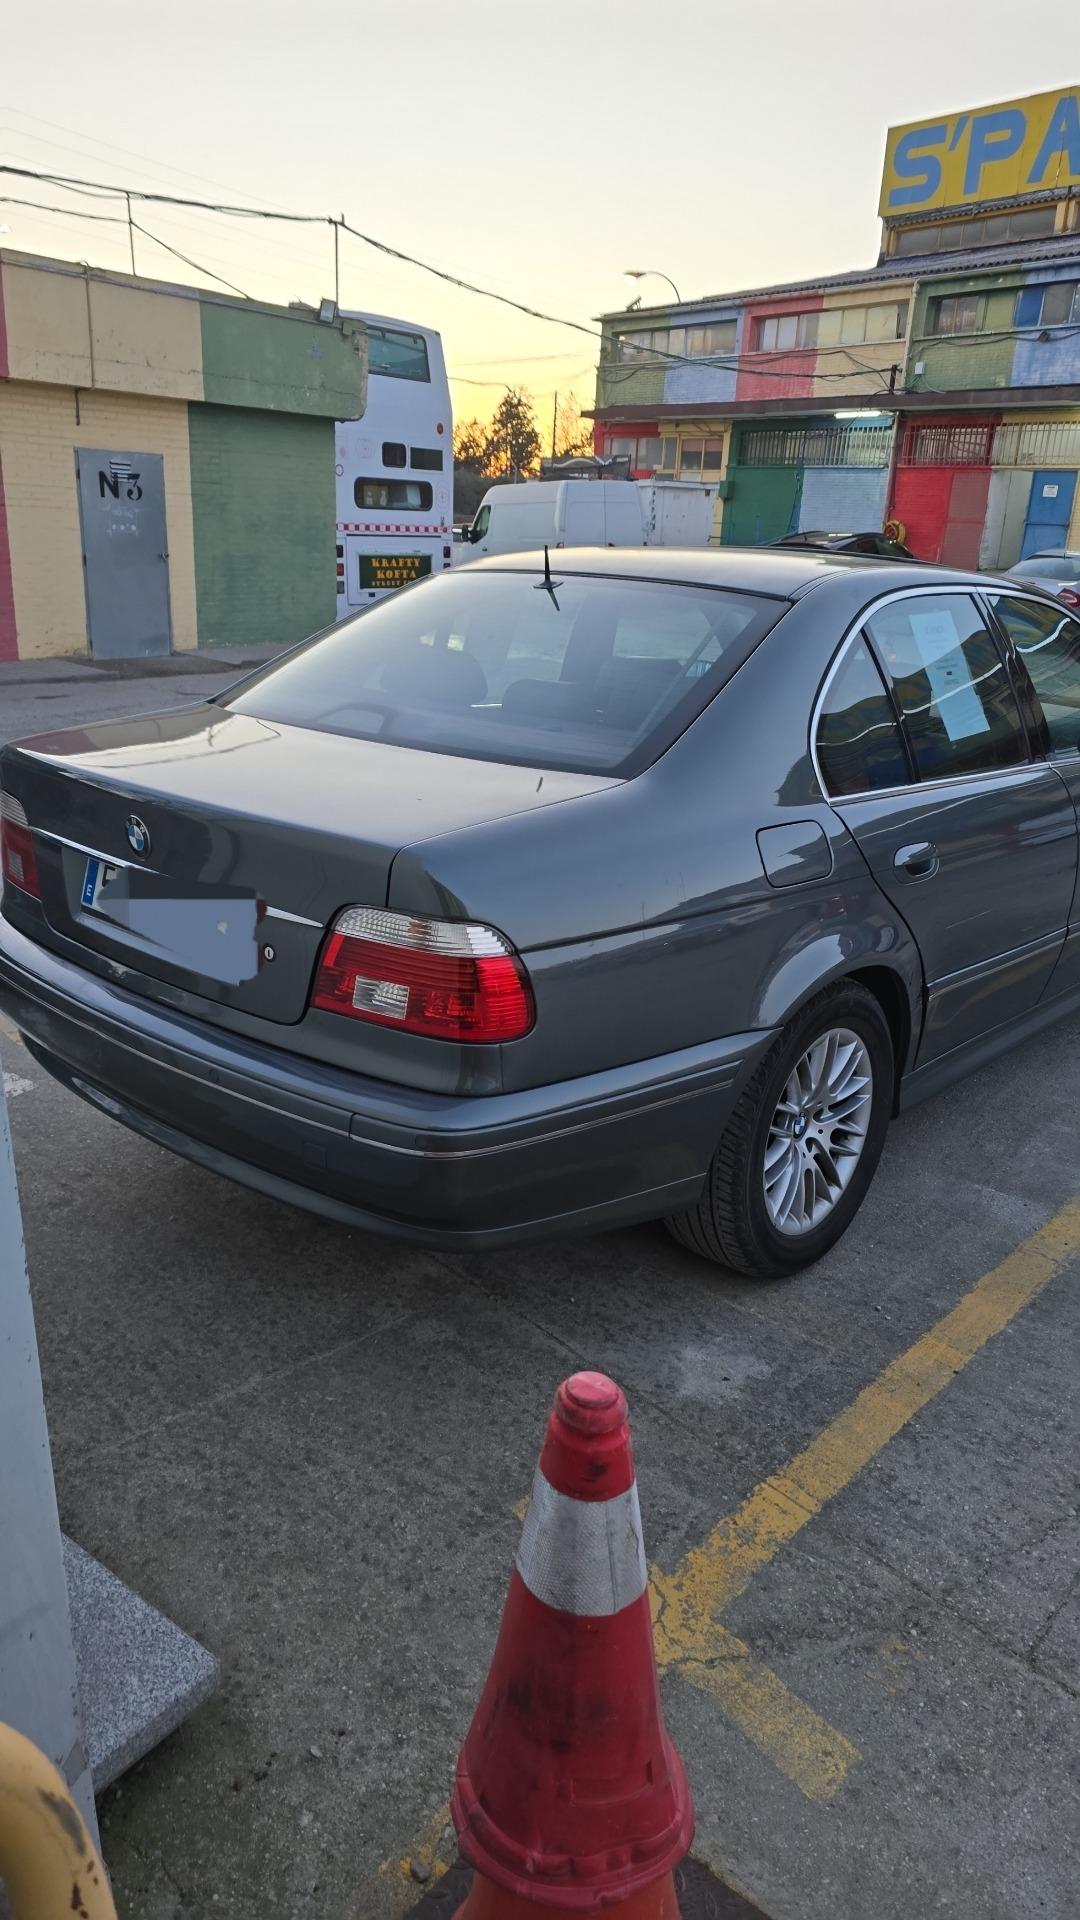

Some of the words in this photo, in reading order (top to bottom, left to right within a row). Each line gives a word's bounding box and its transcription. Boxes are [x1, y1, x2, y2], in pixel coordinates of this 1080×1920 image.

[888, 95, 1080, 207] S'PA
[371, 557, 420, 567] KRAFTY
[376, 569, 417, 579] KOFTA
